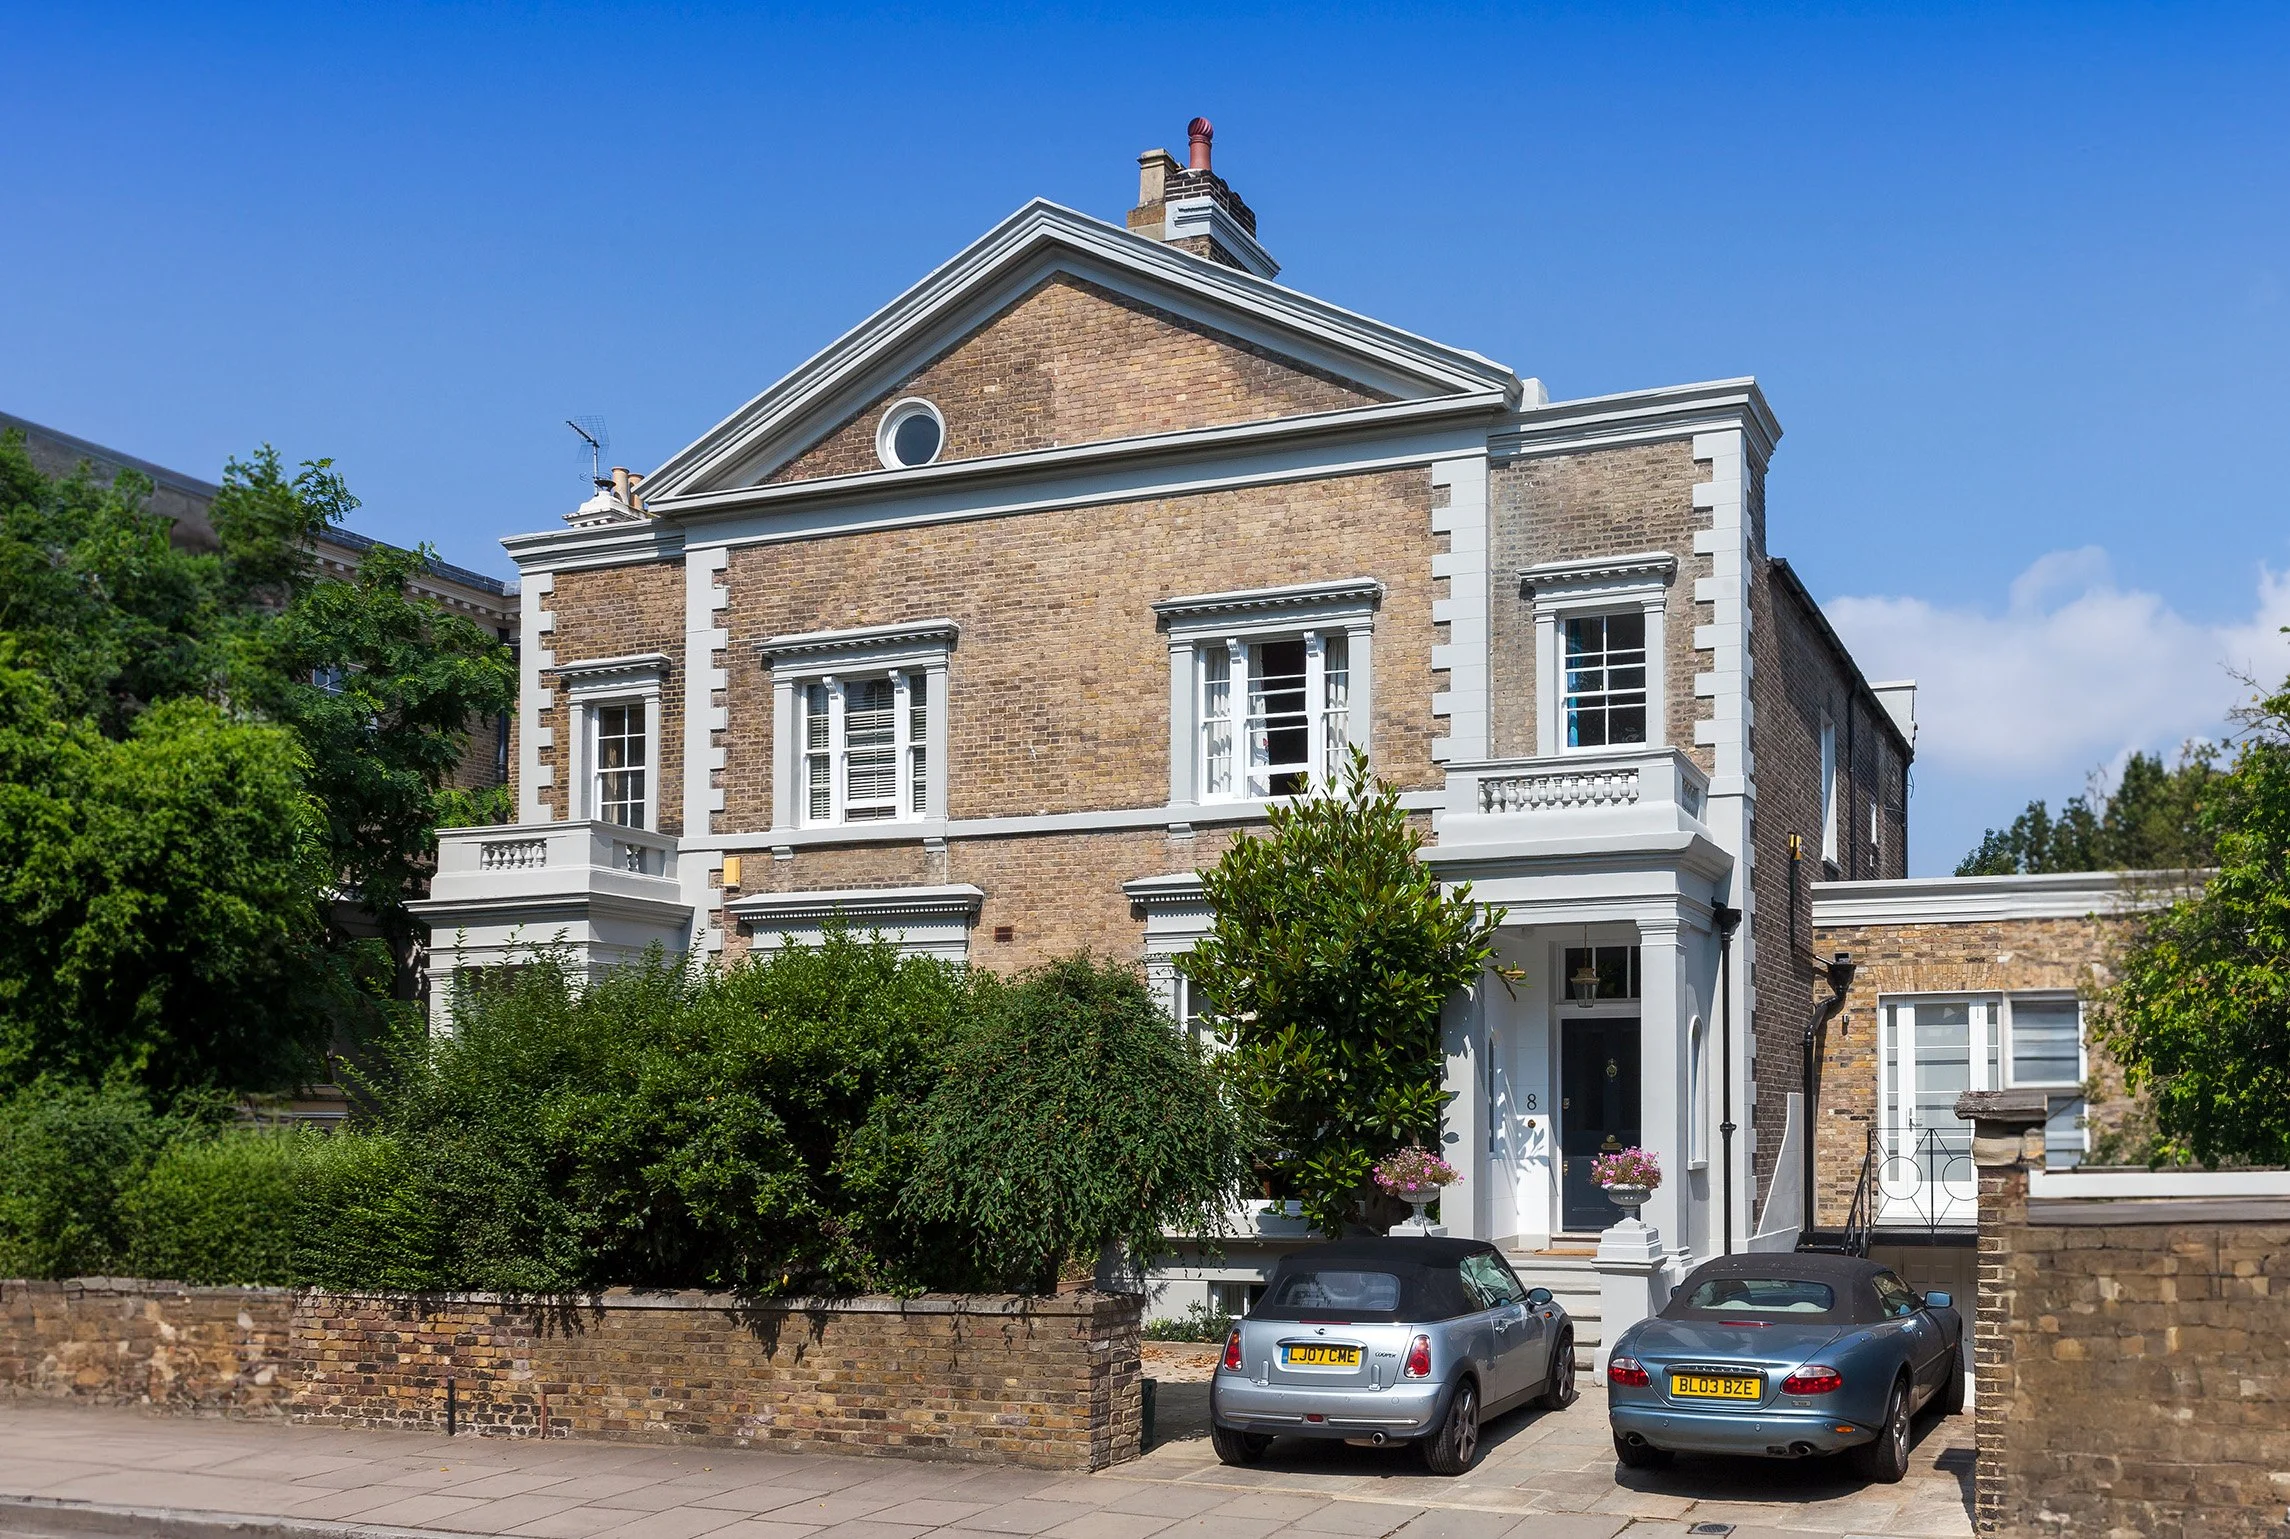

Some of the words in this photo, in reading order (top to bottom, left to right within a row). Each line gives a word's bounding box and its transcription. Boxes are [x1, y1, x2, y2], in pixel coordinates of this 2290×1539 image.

[1527, 1093, 1537, 1111] 8
[1289, 1347, 1326, 1362] LJ07
[1328, 1348, 1356, 1363] CME
[1679, 1378, 1719, 1393] BL03
[1723, 1380, 1753, 1395] BZE
